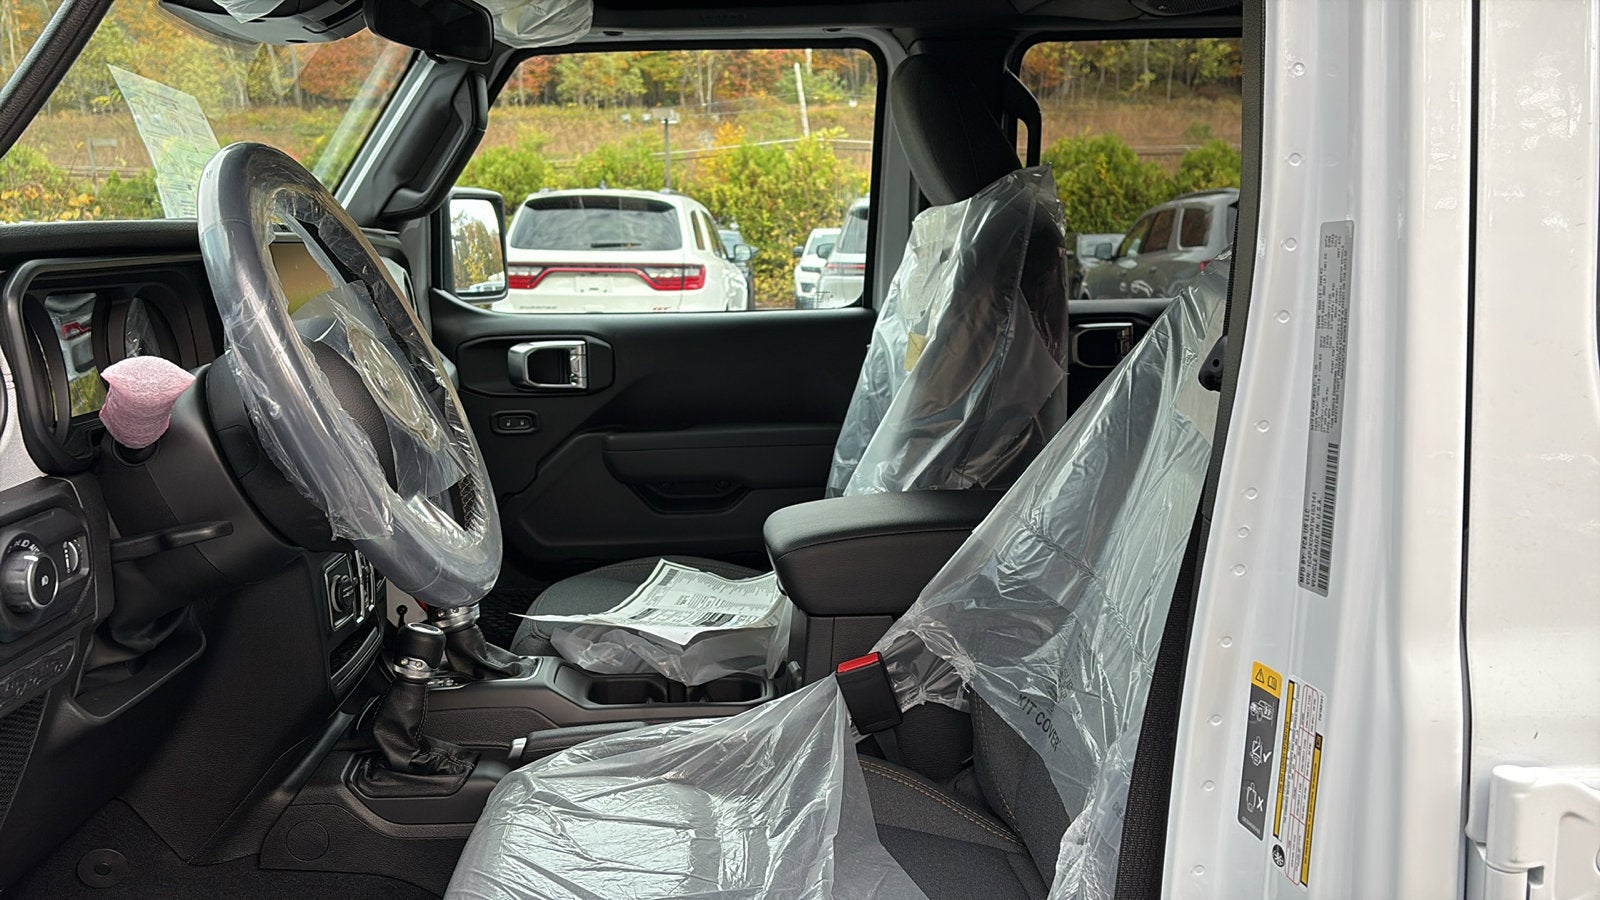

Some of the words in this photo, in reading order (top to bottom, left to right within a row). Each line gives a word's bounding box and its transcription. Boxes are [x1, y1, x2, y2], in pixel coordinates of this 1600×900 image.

[1303, 523, 1309, 533] US
[1018, 694, 1037, 716] KIT
[1036, 712, 1061, 752] COVER
